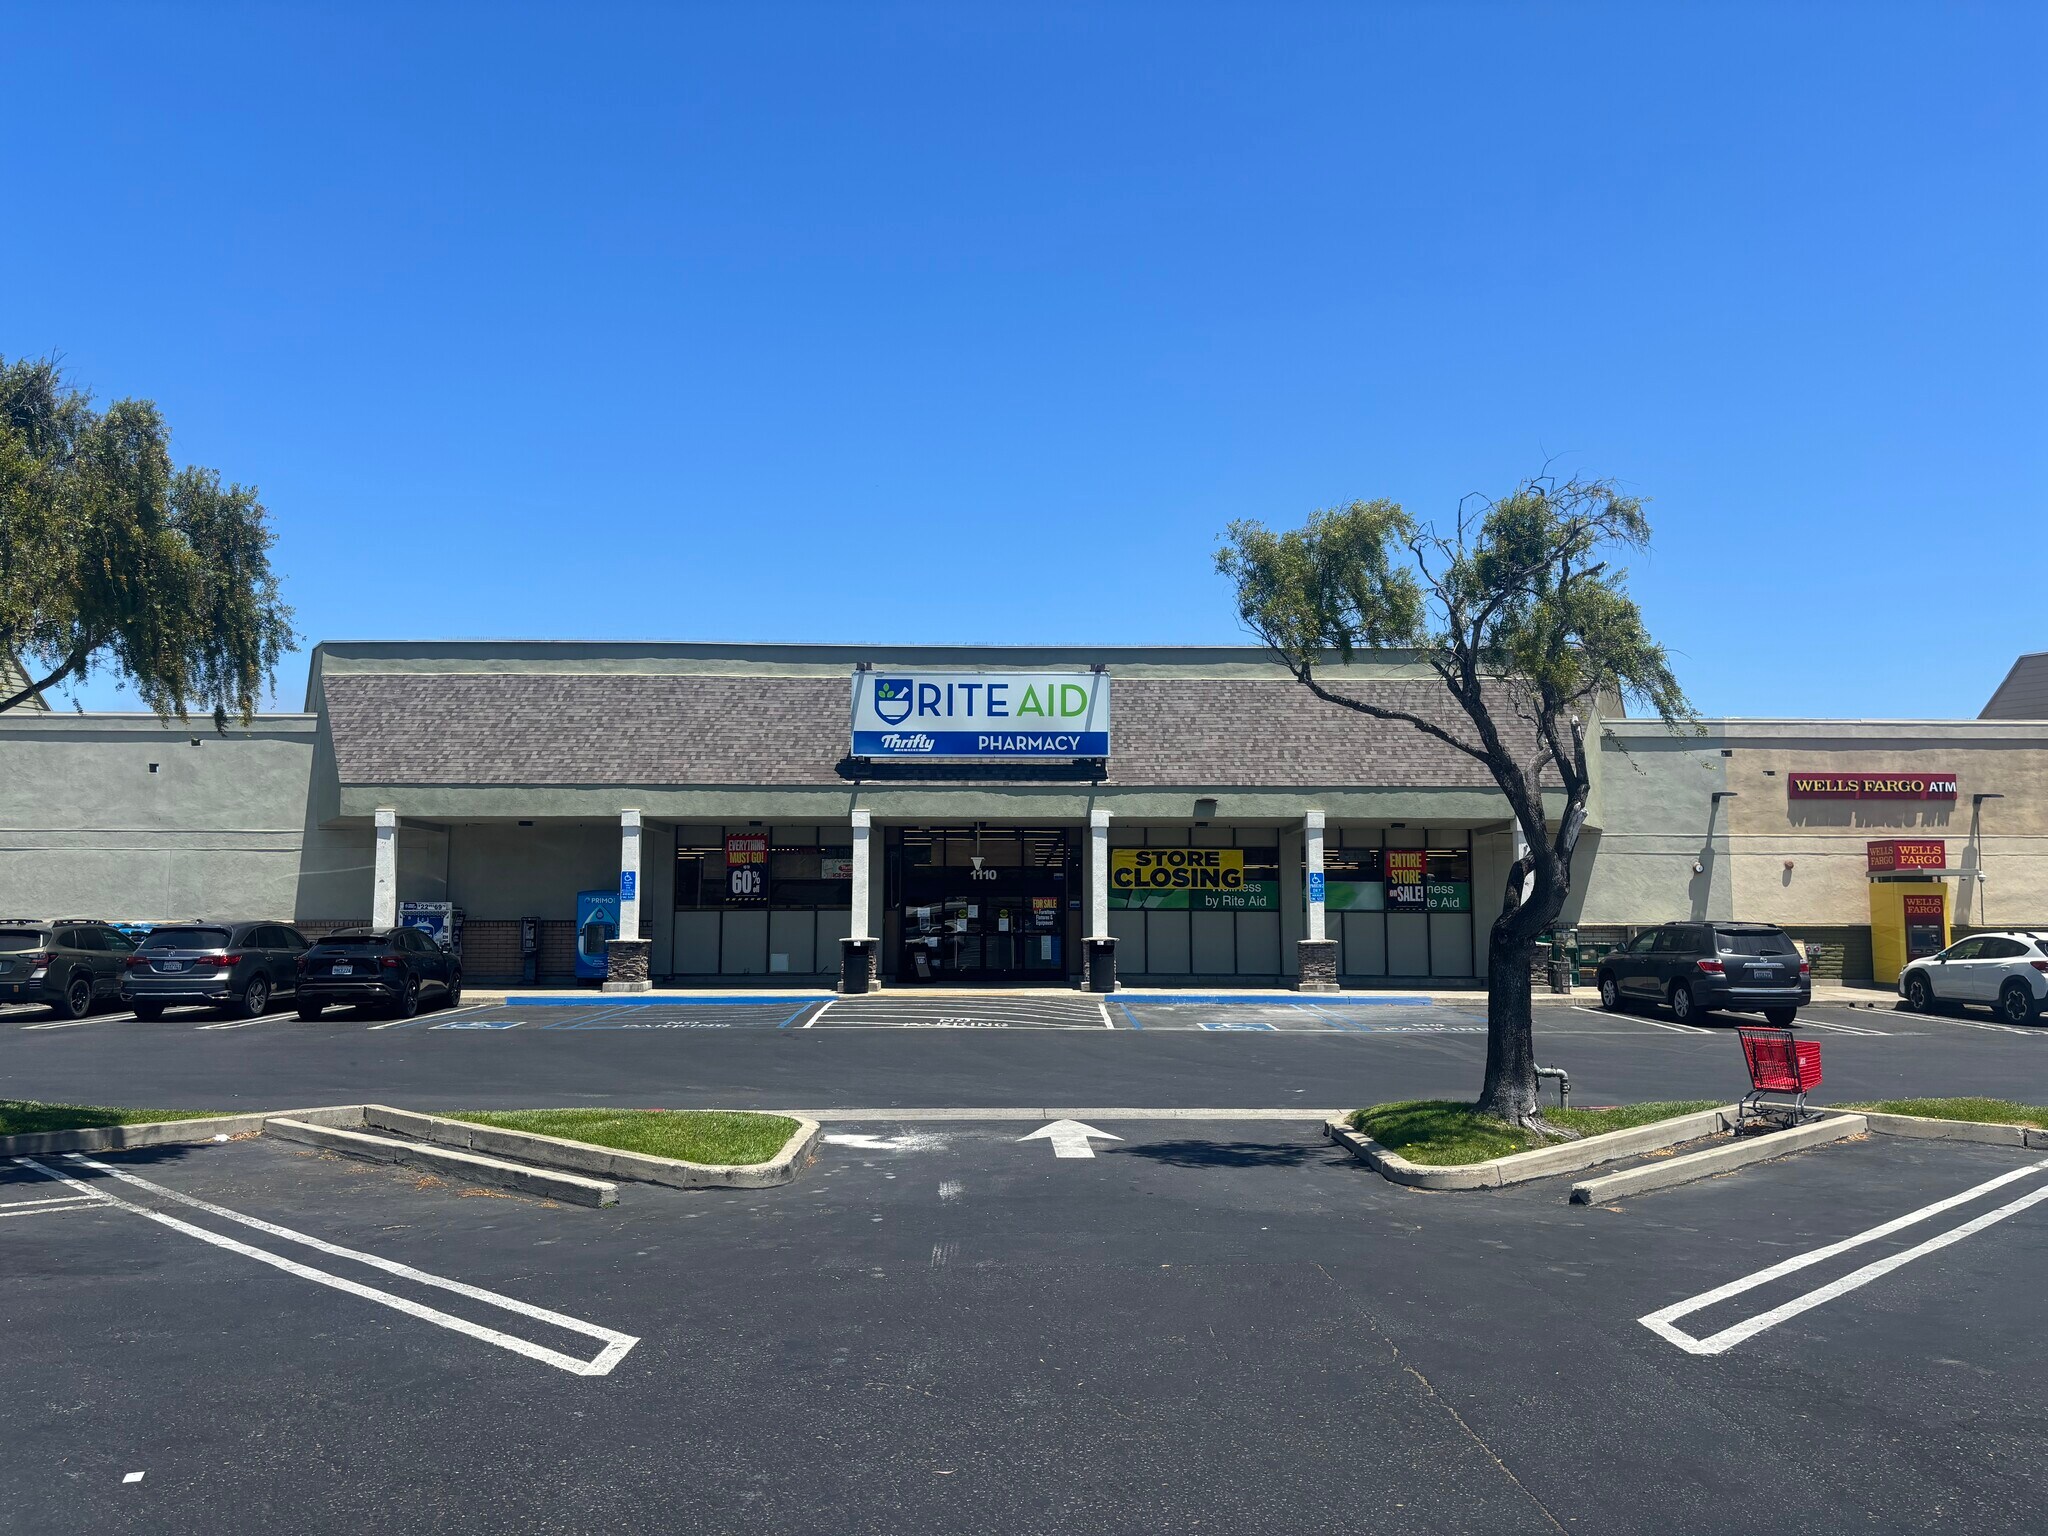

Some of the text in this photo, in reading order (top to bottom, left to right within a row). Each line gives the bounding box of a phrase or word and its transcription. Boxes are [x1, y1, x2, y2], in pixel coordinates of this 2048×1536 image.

[918, 683, 1088, 717] RITE AID
[881, 734, 935, 752] Thrifty
[978, 735, 1081, 751] PHARMACY
[1796, 779, 1956, 793] WELLS FARGO ATM
[728, 839, 766, 851] EVERYTHING
[1869, 846, 1894, 856] WELLS
[1898, 845, 1942, 855] WELLS
[729, 852, 764, 864] MUST GO!
[1135, 850, 1220, 867] STORE
[1389, 853, 1422, 868] ENTIRE
[1870, 855, 1894, 866] FARGO
[1900, 855, 1942, 865] FARGO
[970, 869, 997, 880] 1110
[1113, 867, 1241, 888] CLOSING
[1391, 869, 1422, 885] STORE
[1397, 885, 1424, 902] SALE!
[1426, 885, 1454, 894] ness
[1033, 899, 1057, 908] FOR SALE
[1205, 895, 1267, 908] by Rite Aid
[1426, 897, 1460, 908] te Aid
[1907, 898, 1941, 906] WELLS
[1907, 906, 1941, 914] FARGO
